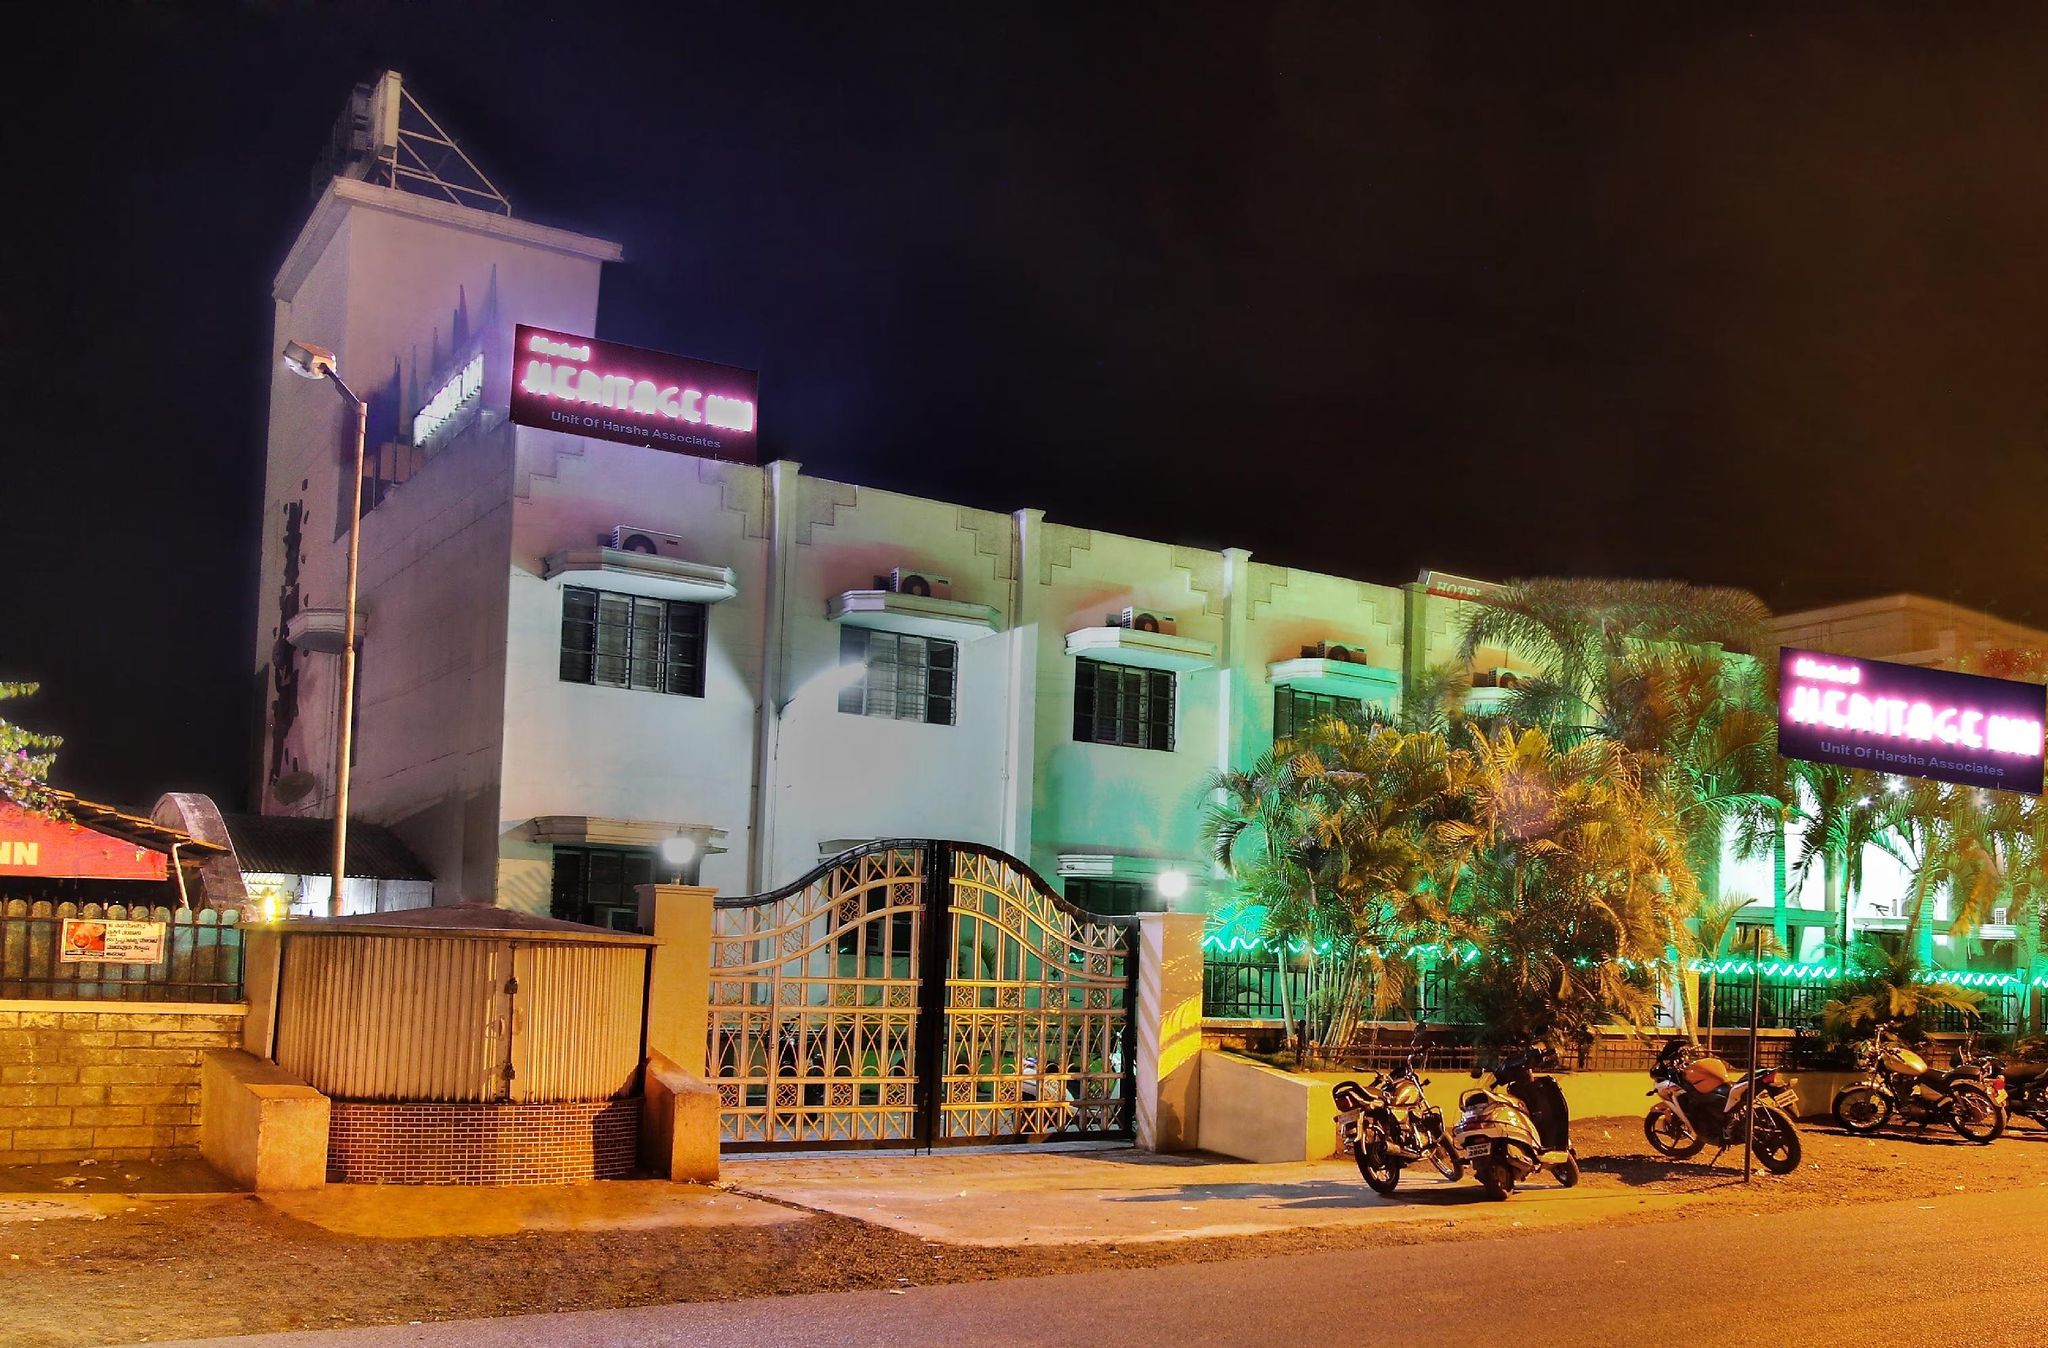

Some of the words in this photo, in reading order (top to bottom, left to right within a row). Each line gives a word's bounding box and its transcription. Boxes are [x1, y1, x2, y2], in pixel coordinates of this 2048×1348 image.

[521, 360, 702, 424] HERITAGE
[551, 411, 580, 425] Unit
[583, 416, 600, 428] Of
[602, 420, 649, 437] Harsha
[651, 429, 721, 449] Associates
[1787, 685, 1984, 749] HERITAGE
[1820, 741, 1851, 756] Unit
[1854, 746, 1872, 758] Of
[1875, 750, 1926, 766] Harsha
[1928, 757, 2005, 777] Associates
